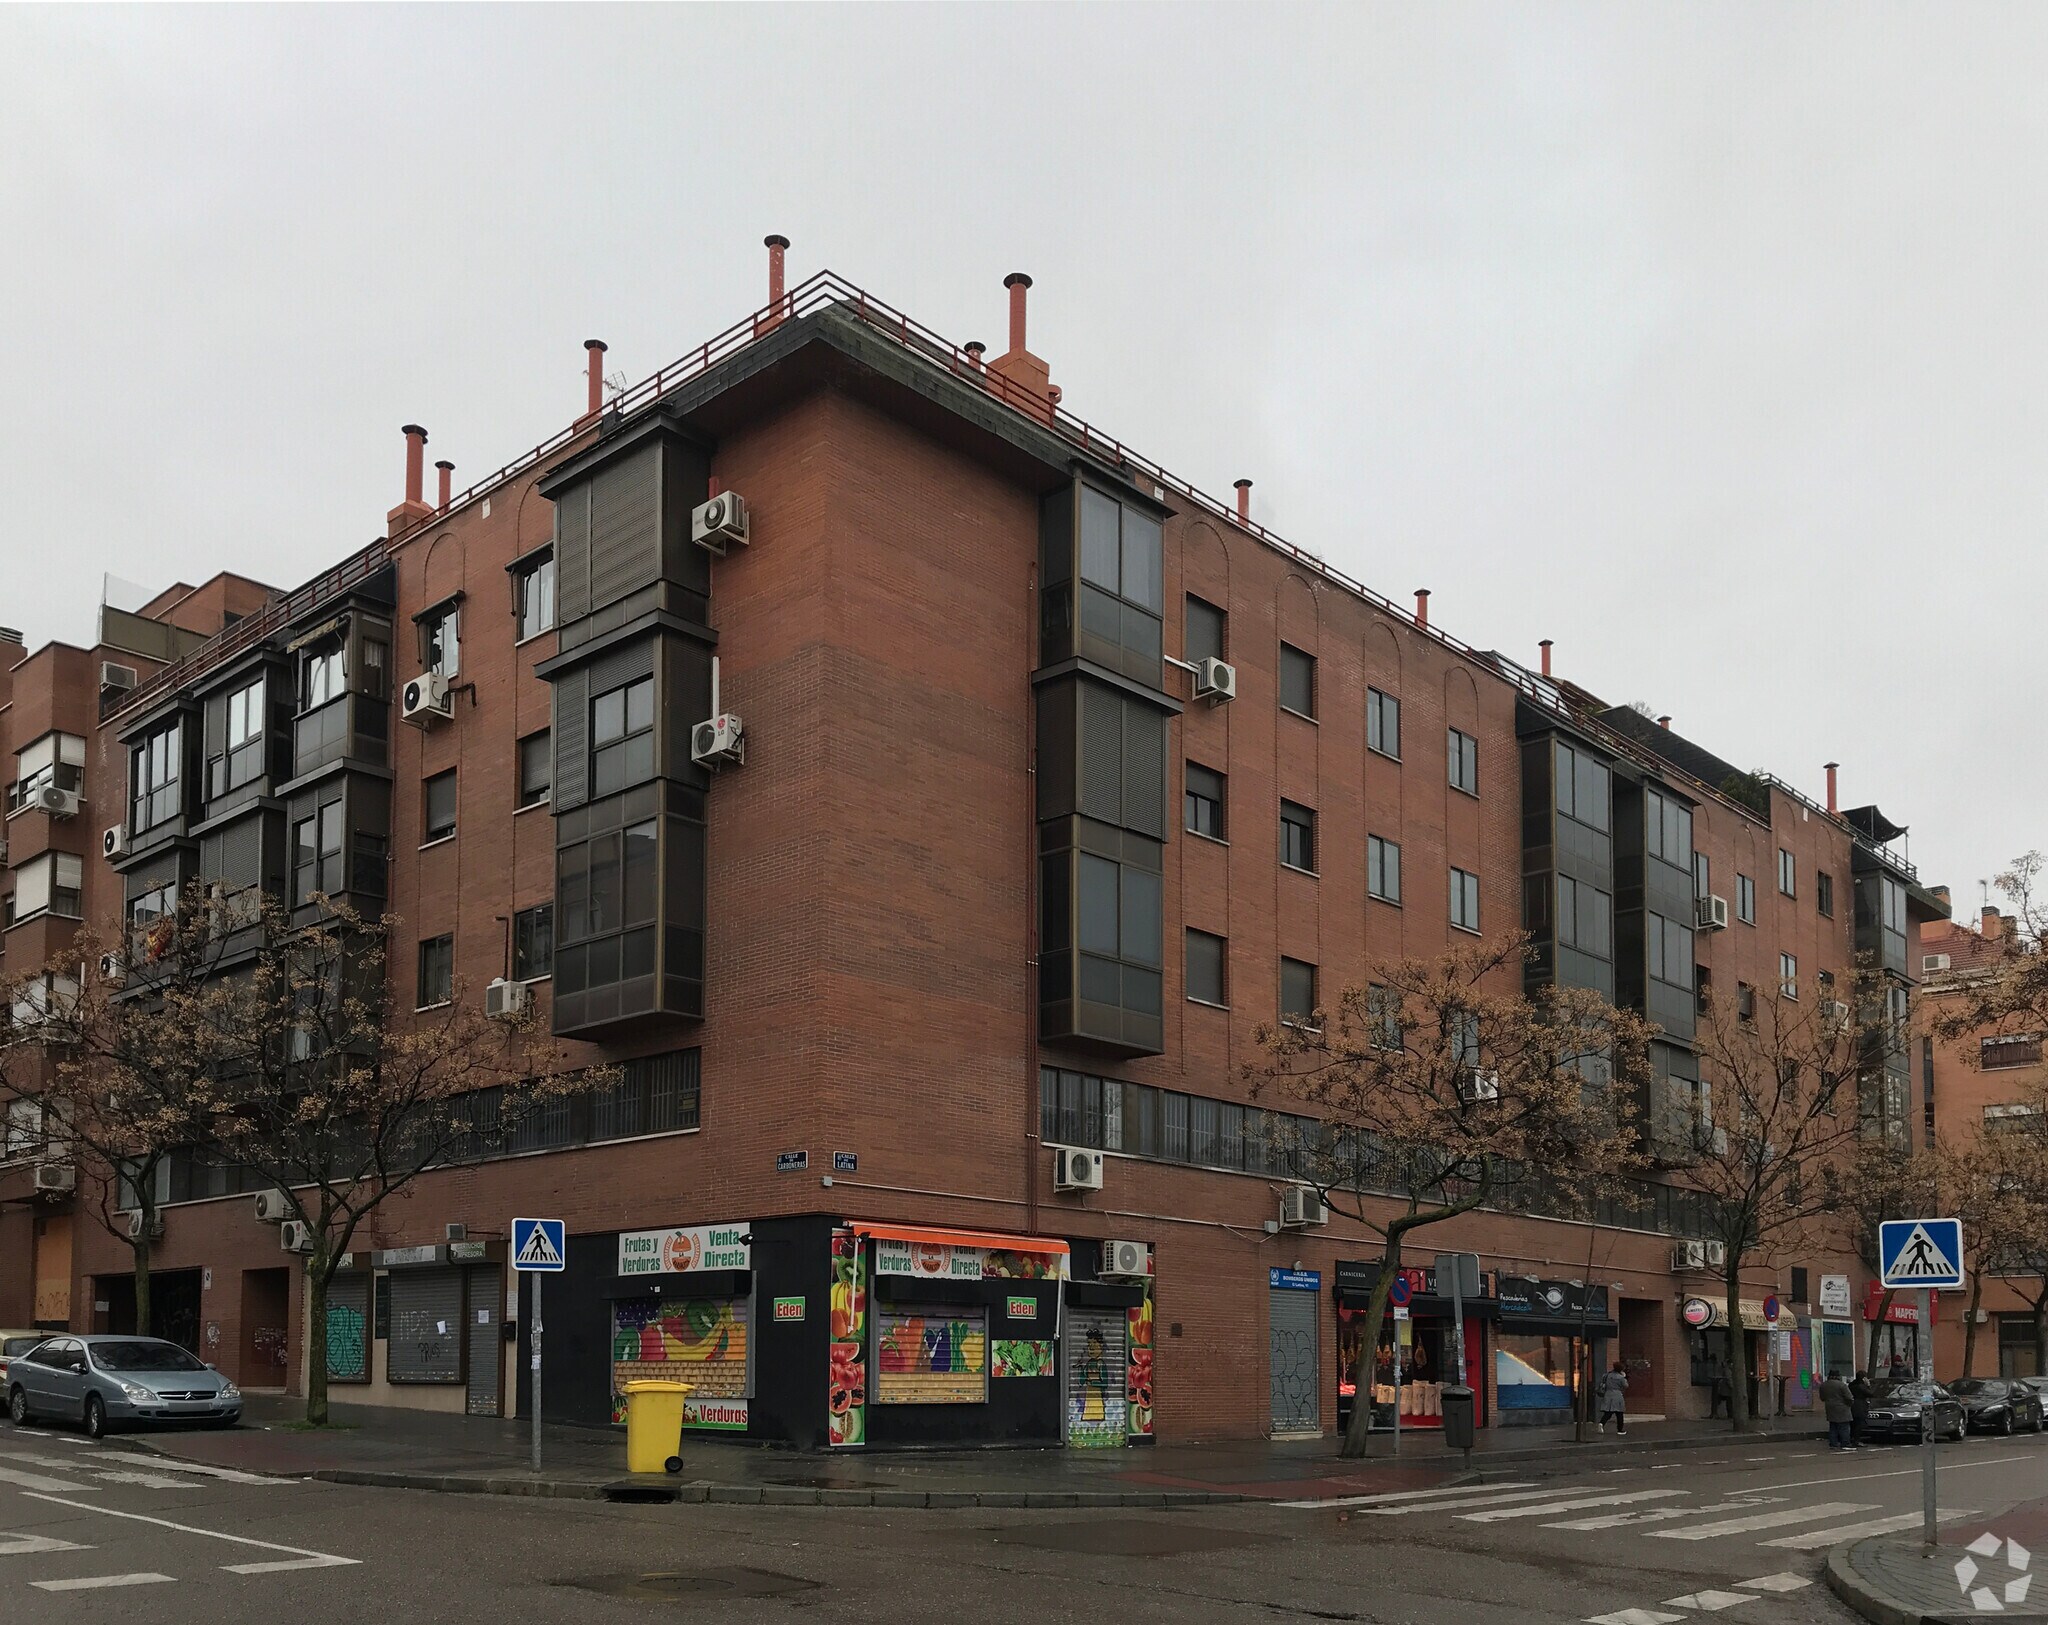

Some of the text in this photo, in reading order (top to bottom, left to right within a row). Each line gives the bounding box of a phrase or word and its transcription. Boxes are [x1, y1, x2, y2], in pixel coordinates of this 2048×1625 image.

[837, 1161, 855, 1170] LATINA
[624, 1237, 651, 1254] Frutas
[653, 1237, 659, 1254] y
[708, 1228, 740, 1247] Venta
[622, 1257, 661, 1273] Verduras
[704, 1250, 745, 1268] Directa
[879, 1253, 912, 1272] Verduras
[951, 1258, 980, 1276] Directa
[776, 1302, 802, 1317] Eden
[1010, 1301, 1034, 1315] Eden
[1894, 1306, 1919, 1320] MAPFR
[699, 1404, 748, 1424] Verduras
